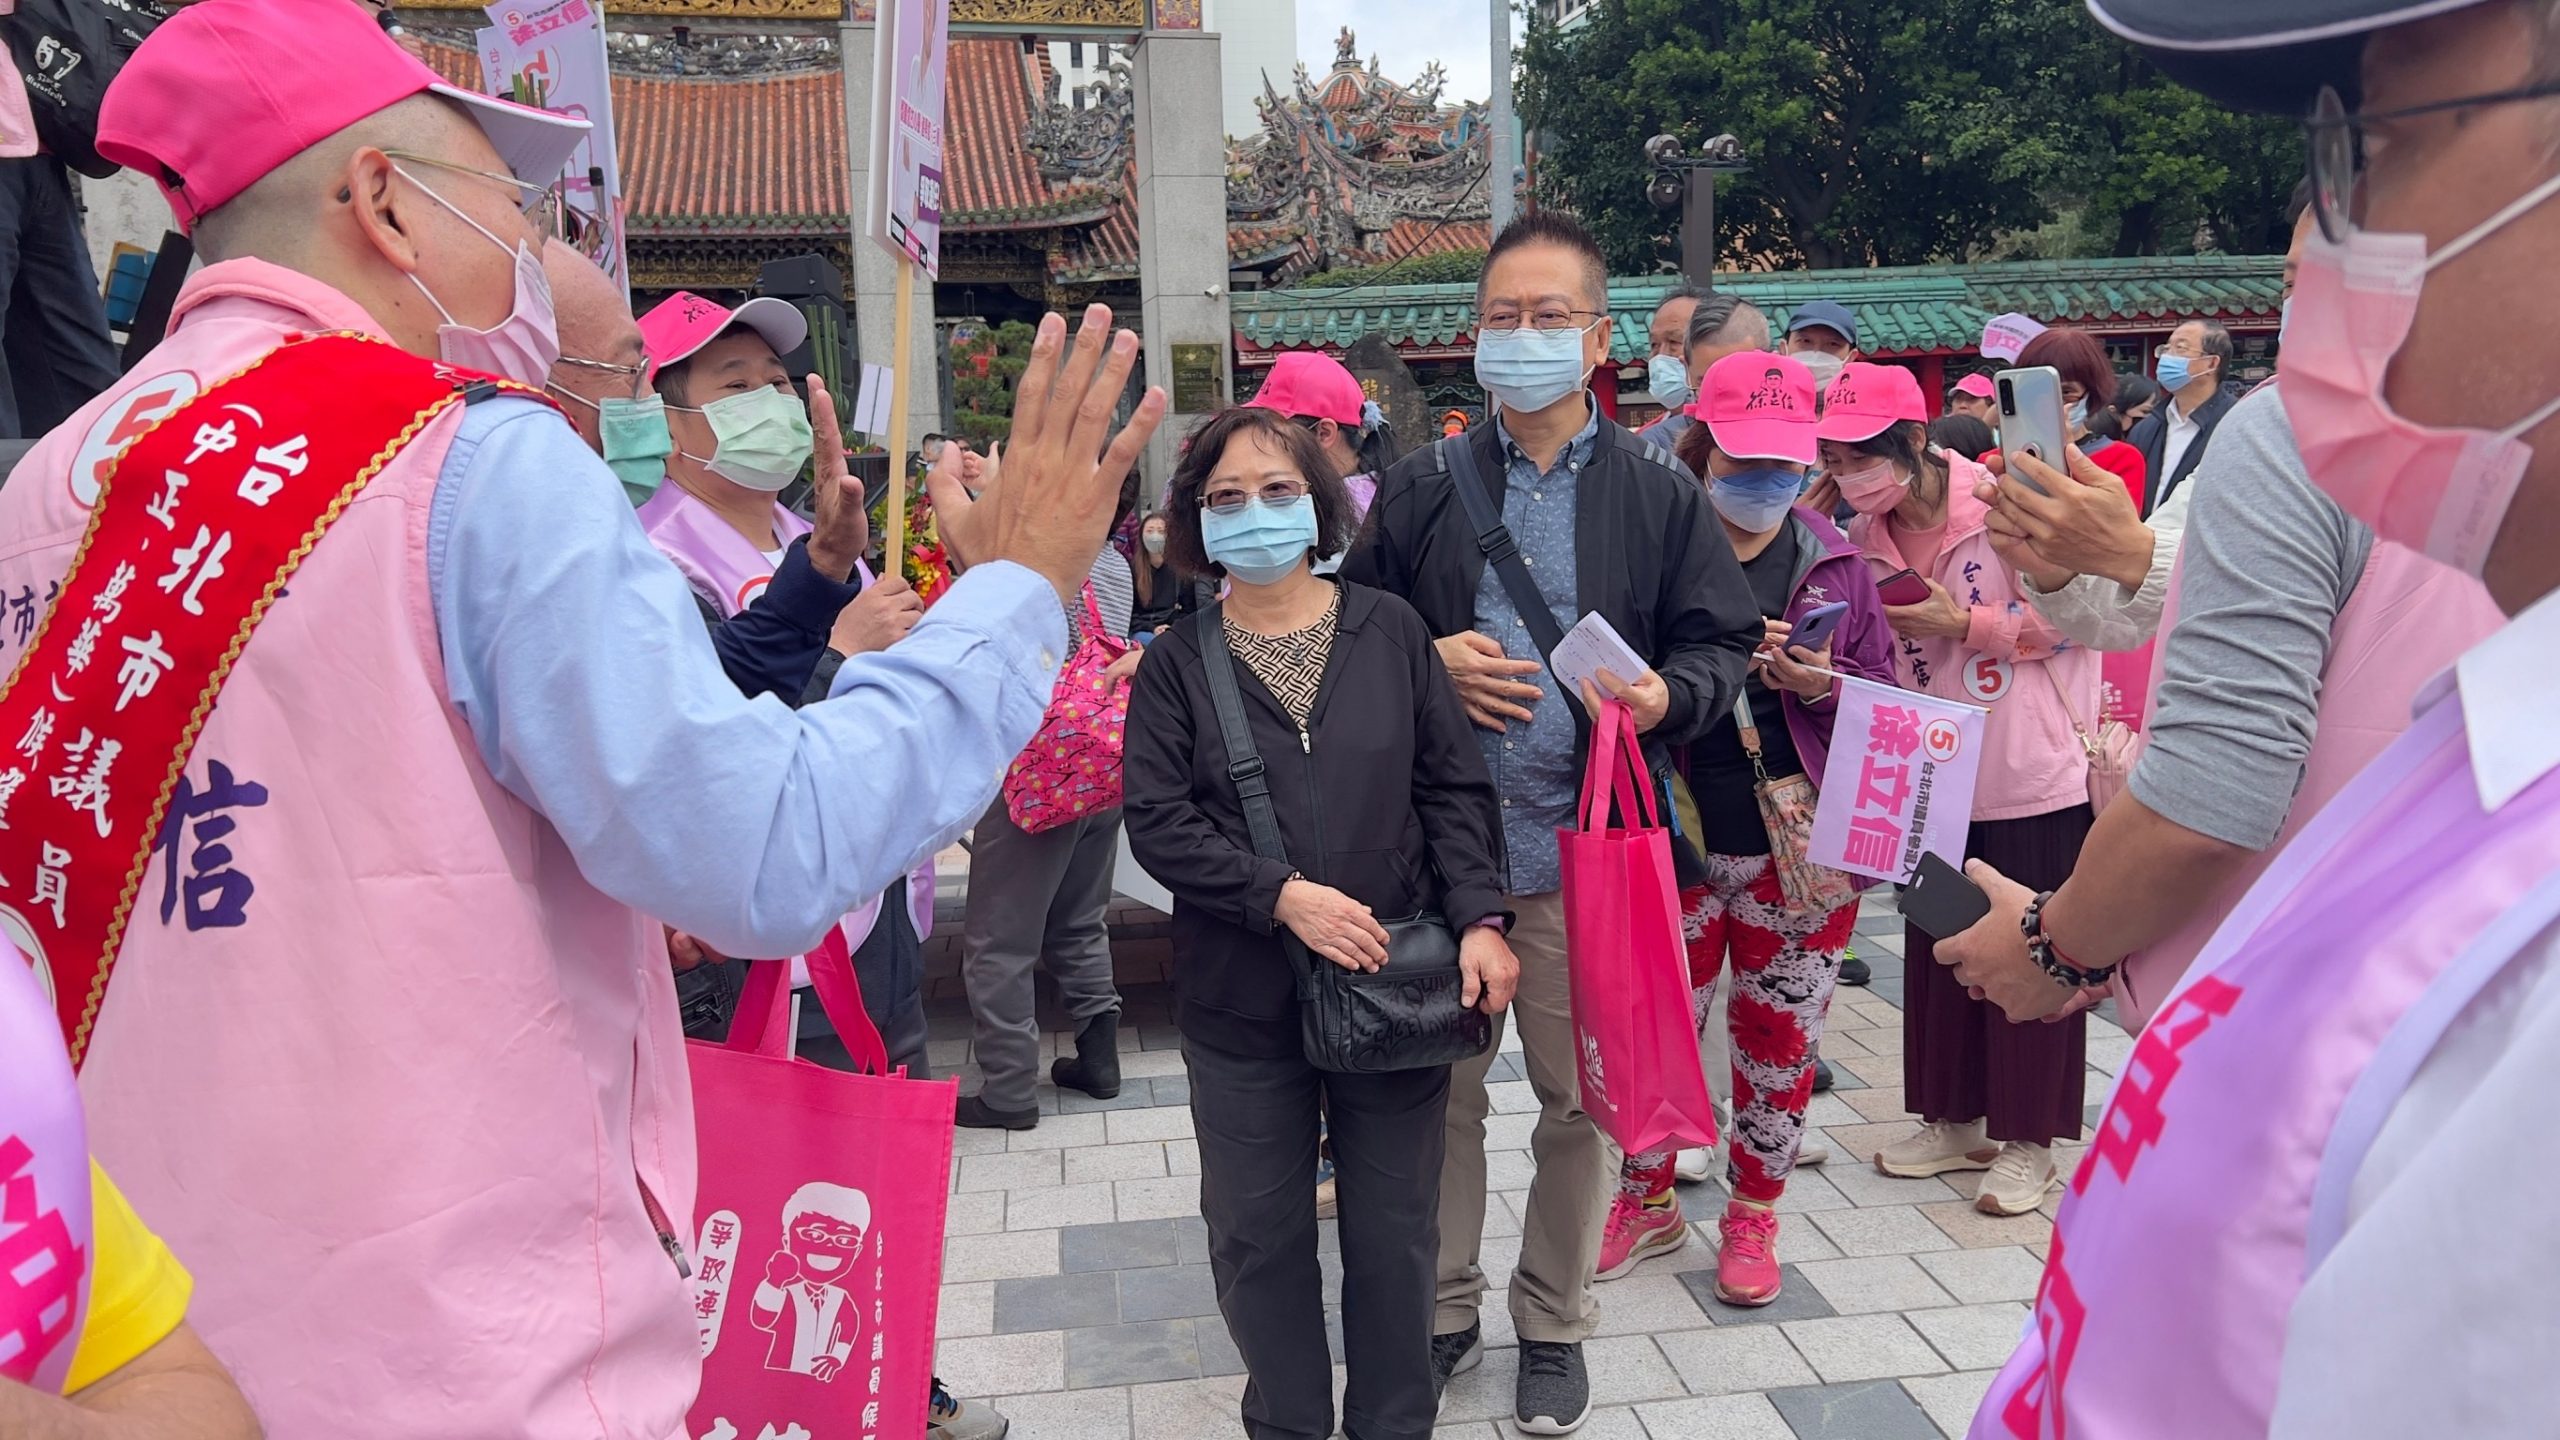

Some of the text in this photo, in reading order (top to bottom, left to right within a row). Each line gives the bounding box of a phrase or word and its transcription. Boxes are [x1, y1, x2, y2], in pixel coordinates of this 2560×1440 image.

[507, 12, 520, 26] 5
[508, 0, 590, 47] 徐立信
[28, 433, 310, 930] 台北市議員
[1976, 658, 2002, 694] 5
[1842, 703, 1922, 873] 徐立信
[1929, 728, 1955, 752] 5
[151, 759, 268, 931] 信
[862, 1231, 884, 1440] 台北市議員候
